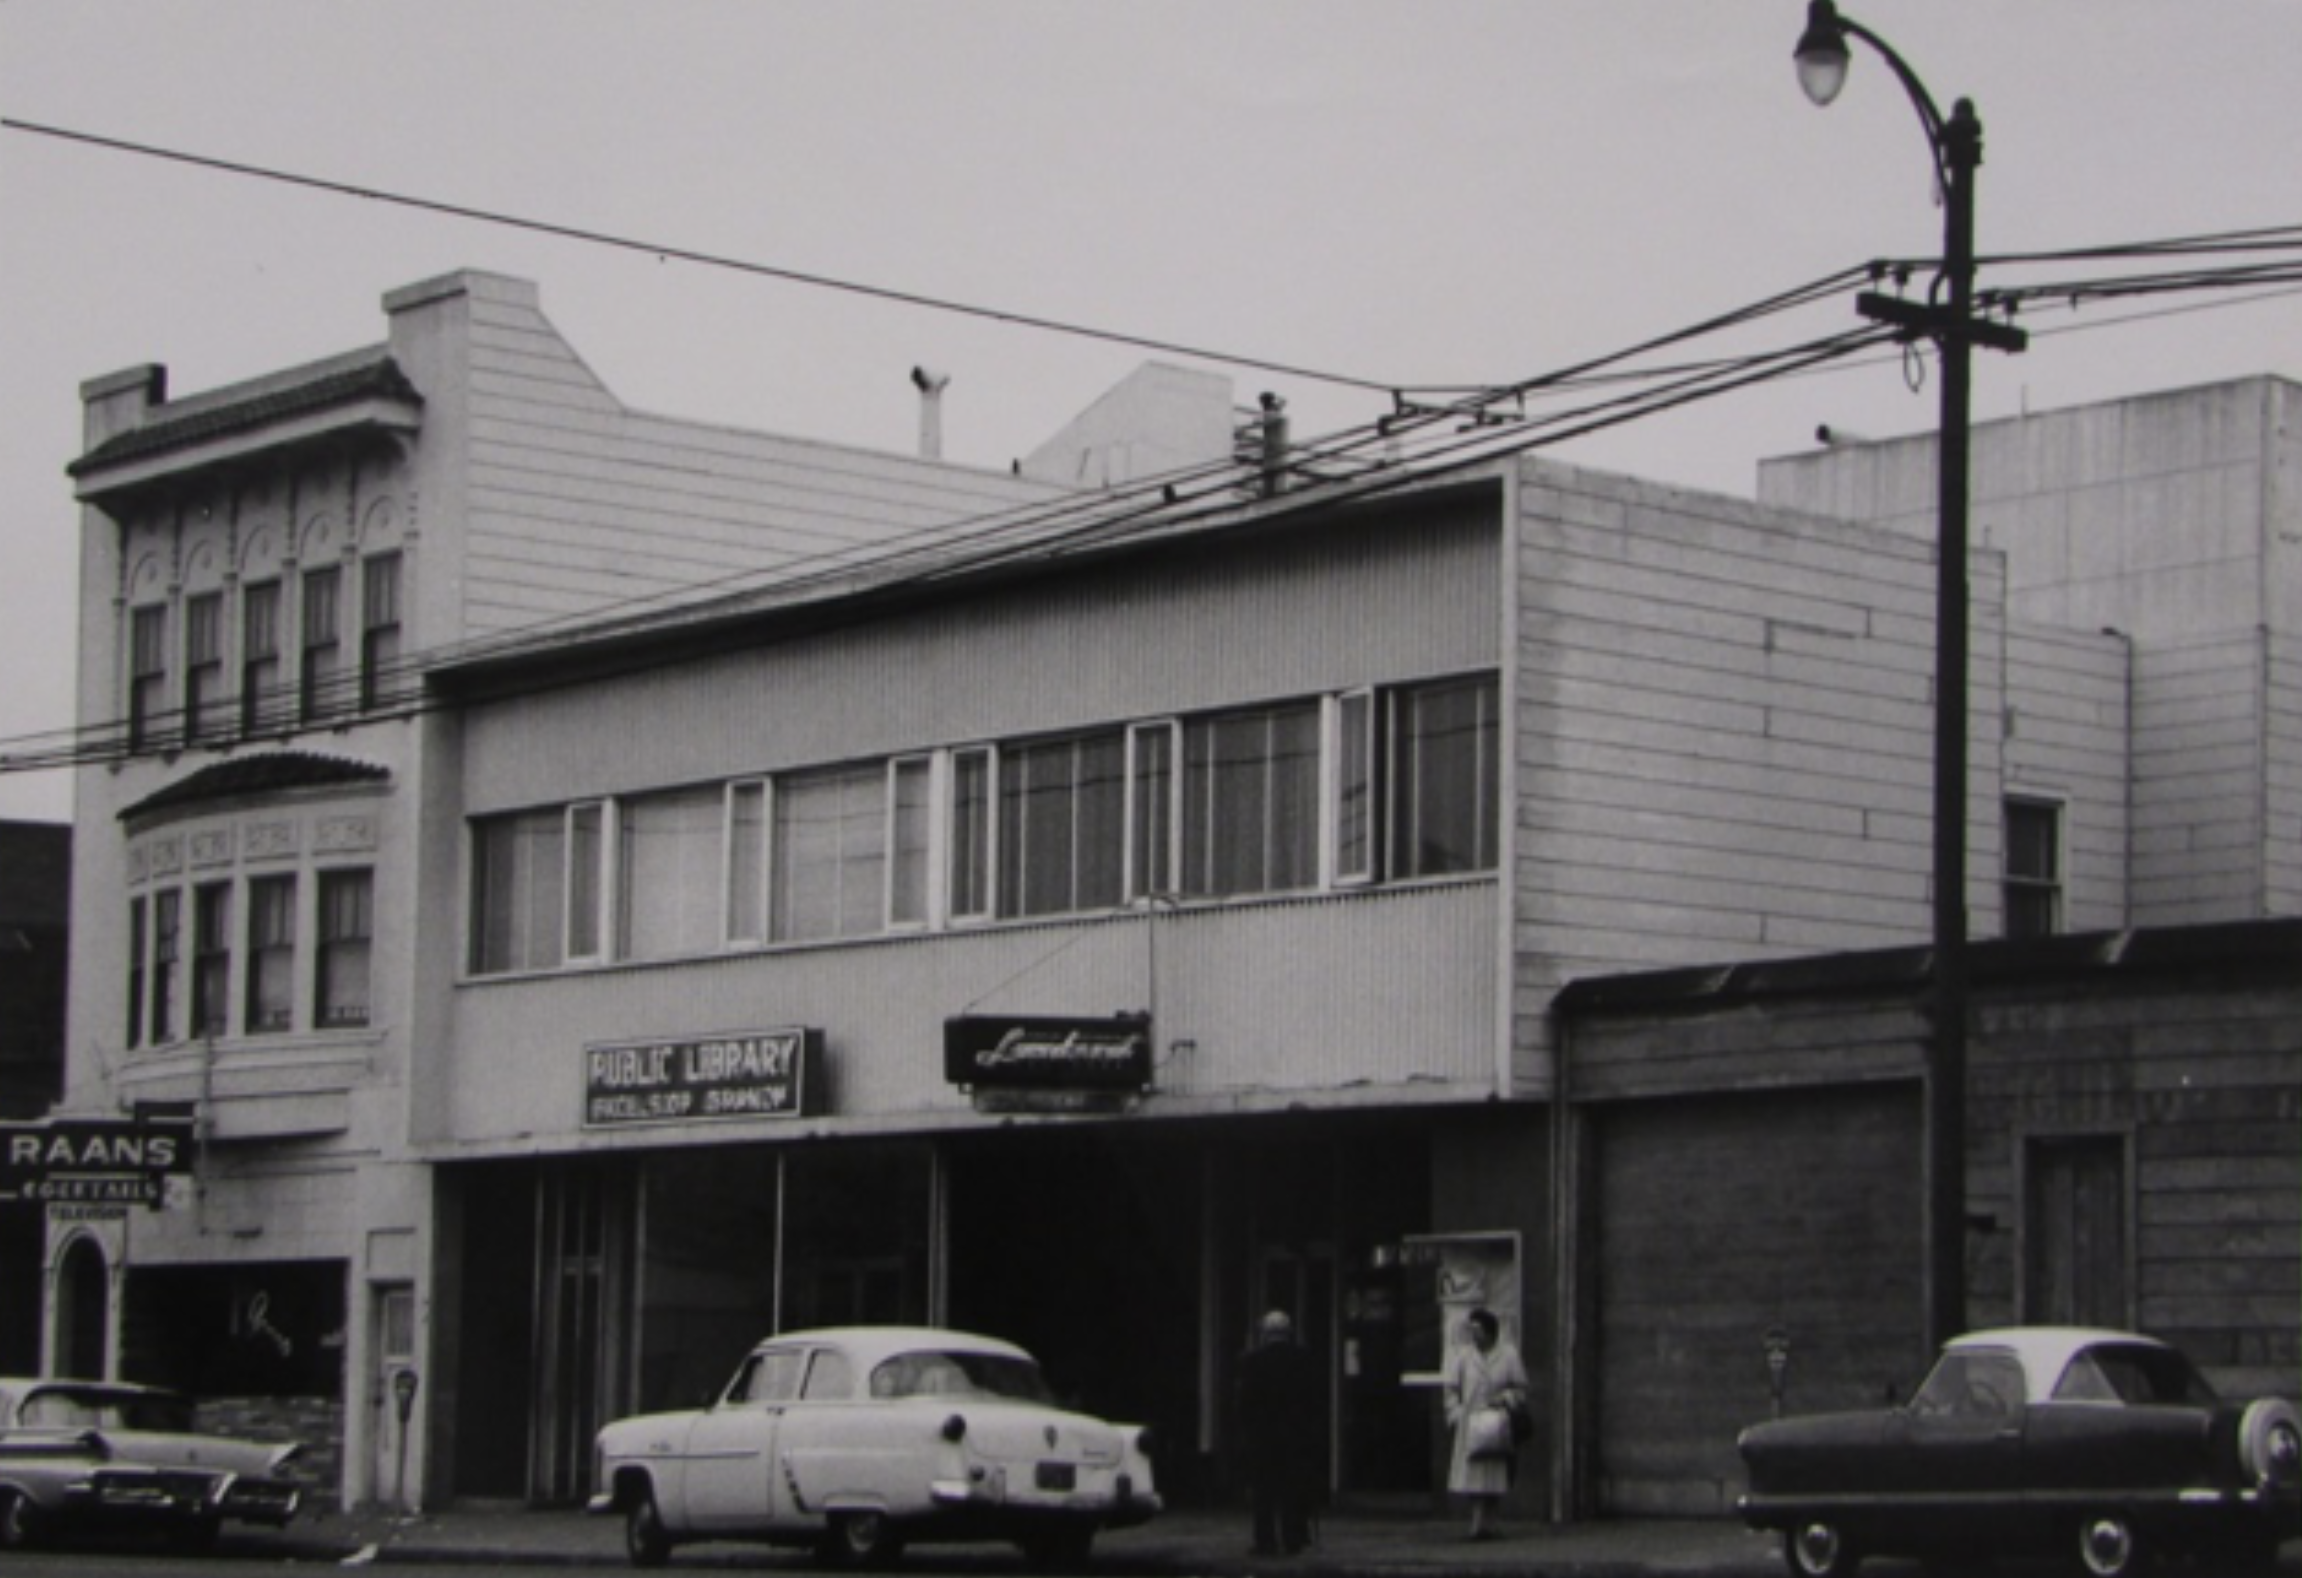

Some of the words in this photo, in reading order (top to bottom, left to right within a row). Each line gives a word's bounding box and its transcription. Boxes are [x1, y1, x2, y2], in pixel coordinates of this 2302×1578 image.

[590, 1046, 673, 1087] PUBLIC
[684, 1038, 795, 1081] LIBRARY
[10, 1134, 177, 1166] RAANS
[22, 1180, 158, 1199] COCKTAILS
